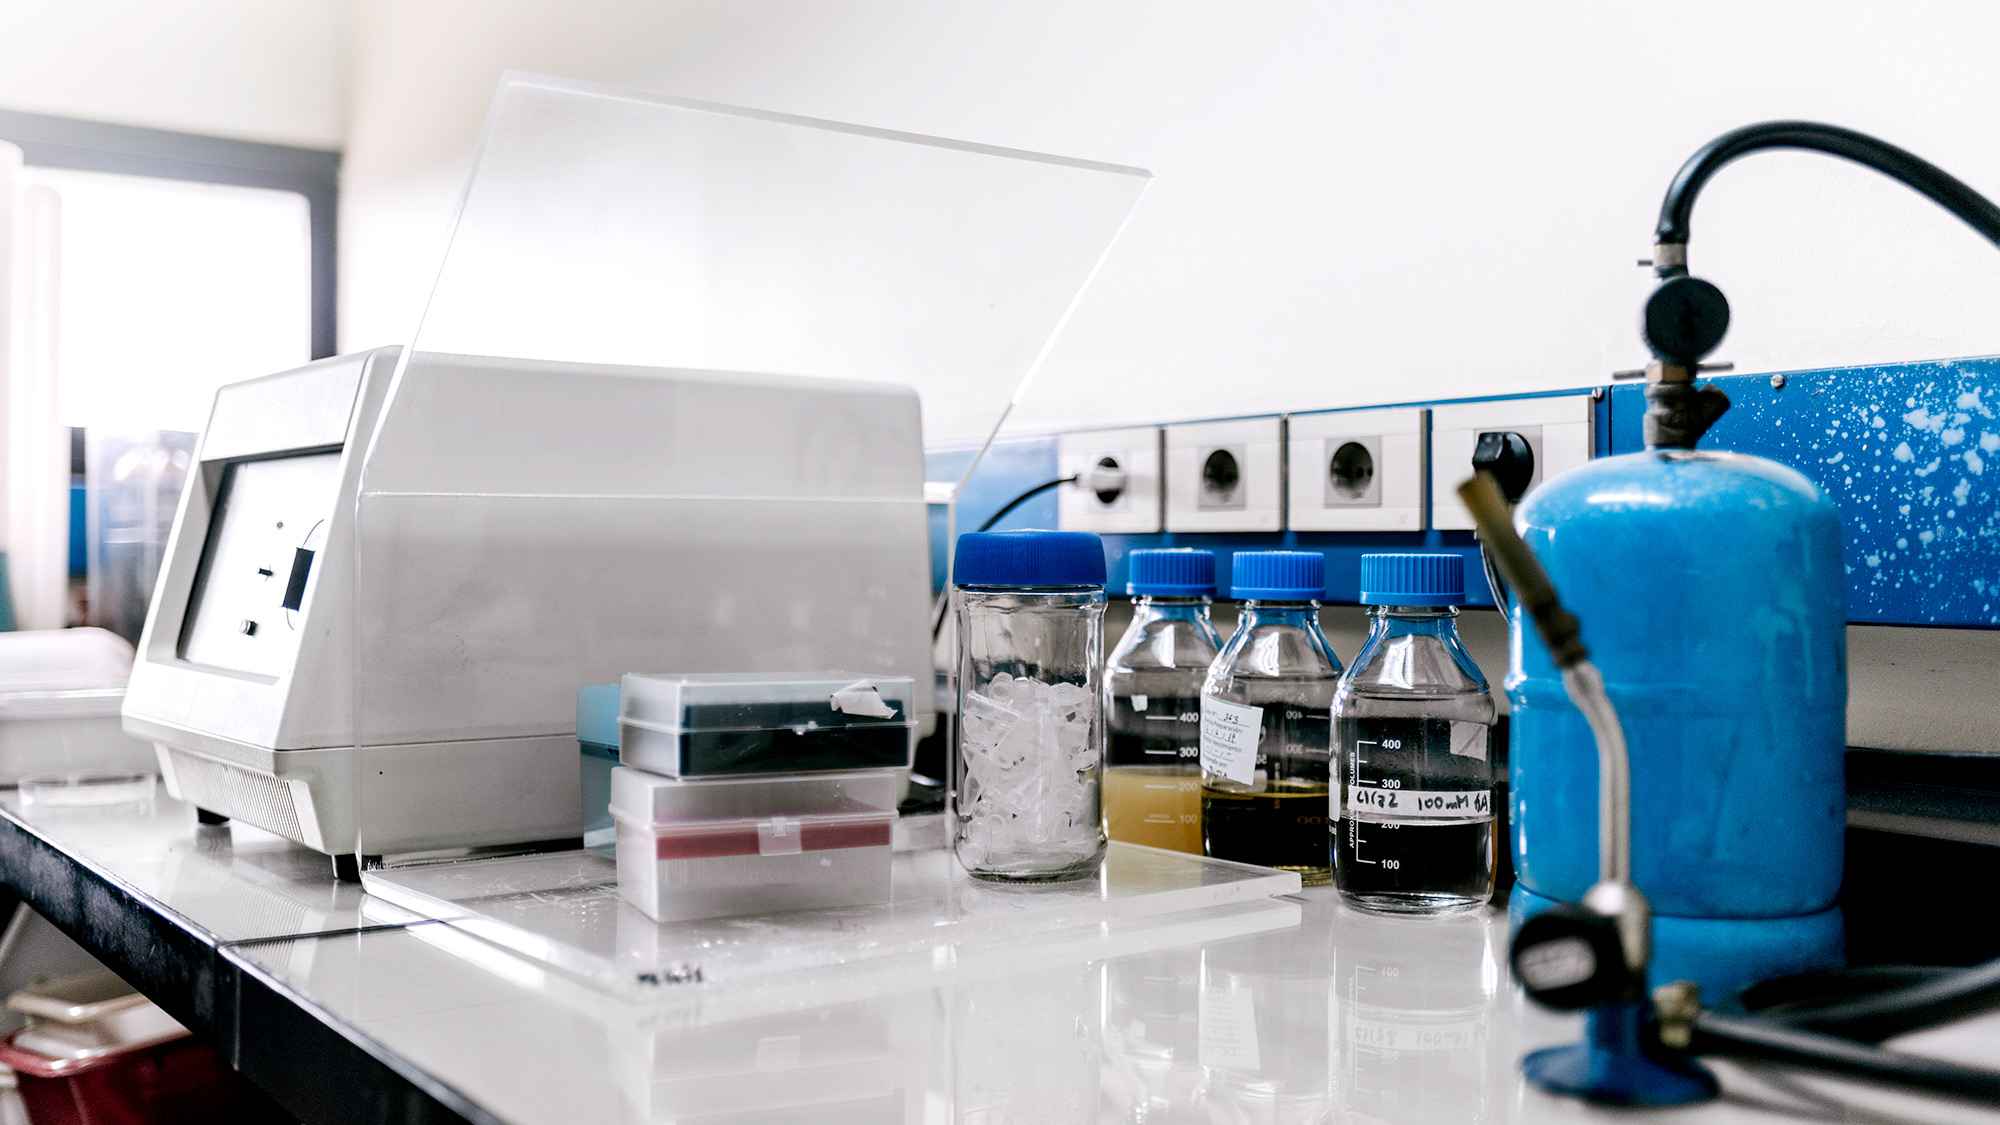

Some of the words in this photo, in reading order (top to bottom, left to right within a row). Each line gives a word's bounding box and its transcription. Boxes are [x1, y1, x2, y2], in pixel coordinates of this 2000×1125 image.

[1181, 712, 1199, 722] 400
[1382, 740, 1401, 749] 400
[1180, 747, 1198, 757] 300
[1180, 782, 1198, 792] 200
[1382, 779, 1401, 789] 300
[1180, 814, 1198, 824] 100
[1381, 859, 1400, 870] 100
